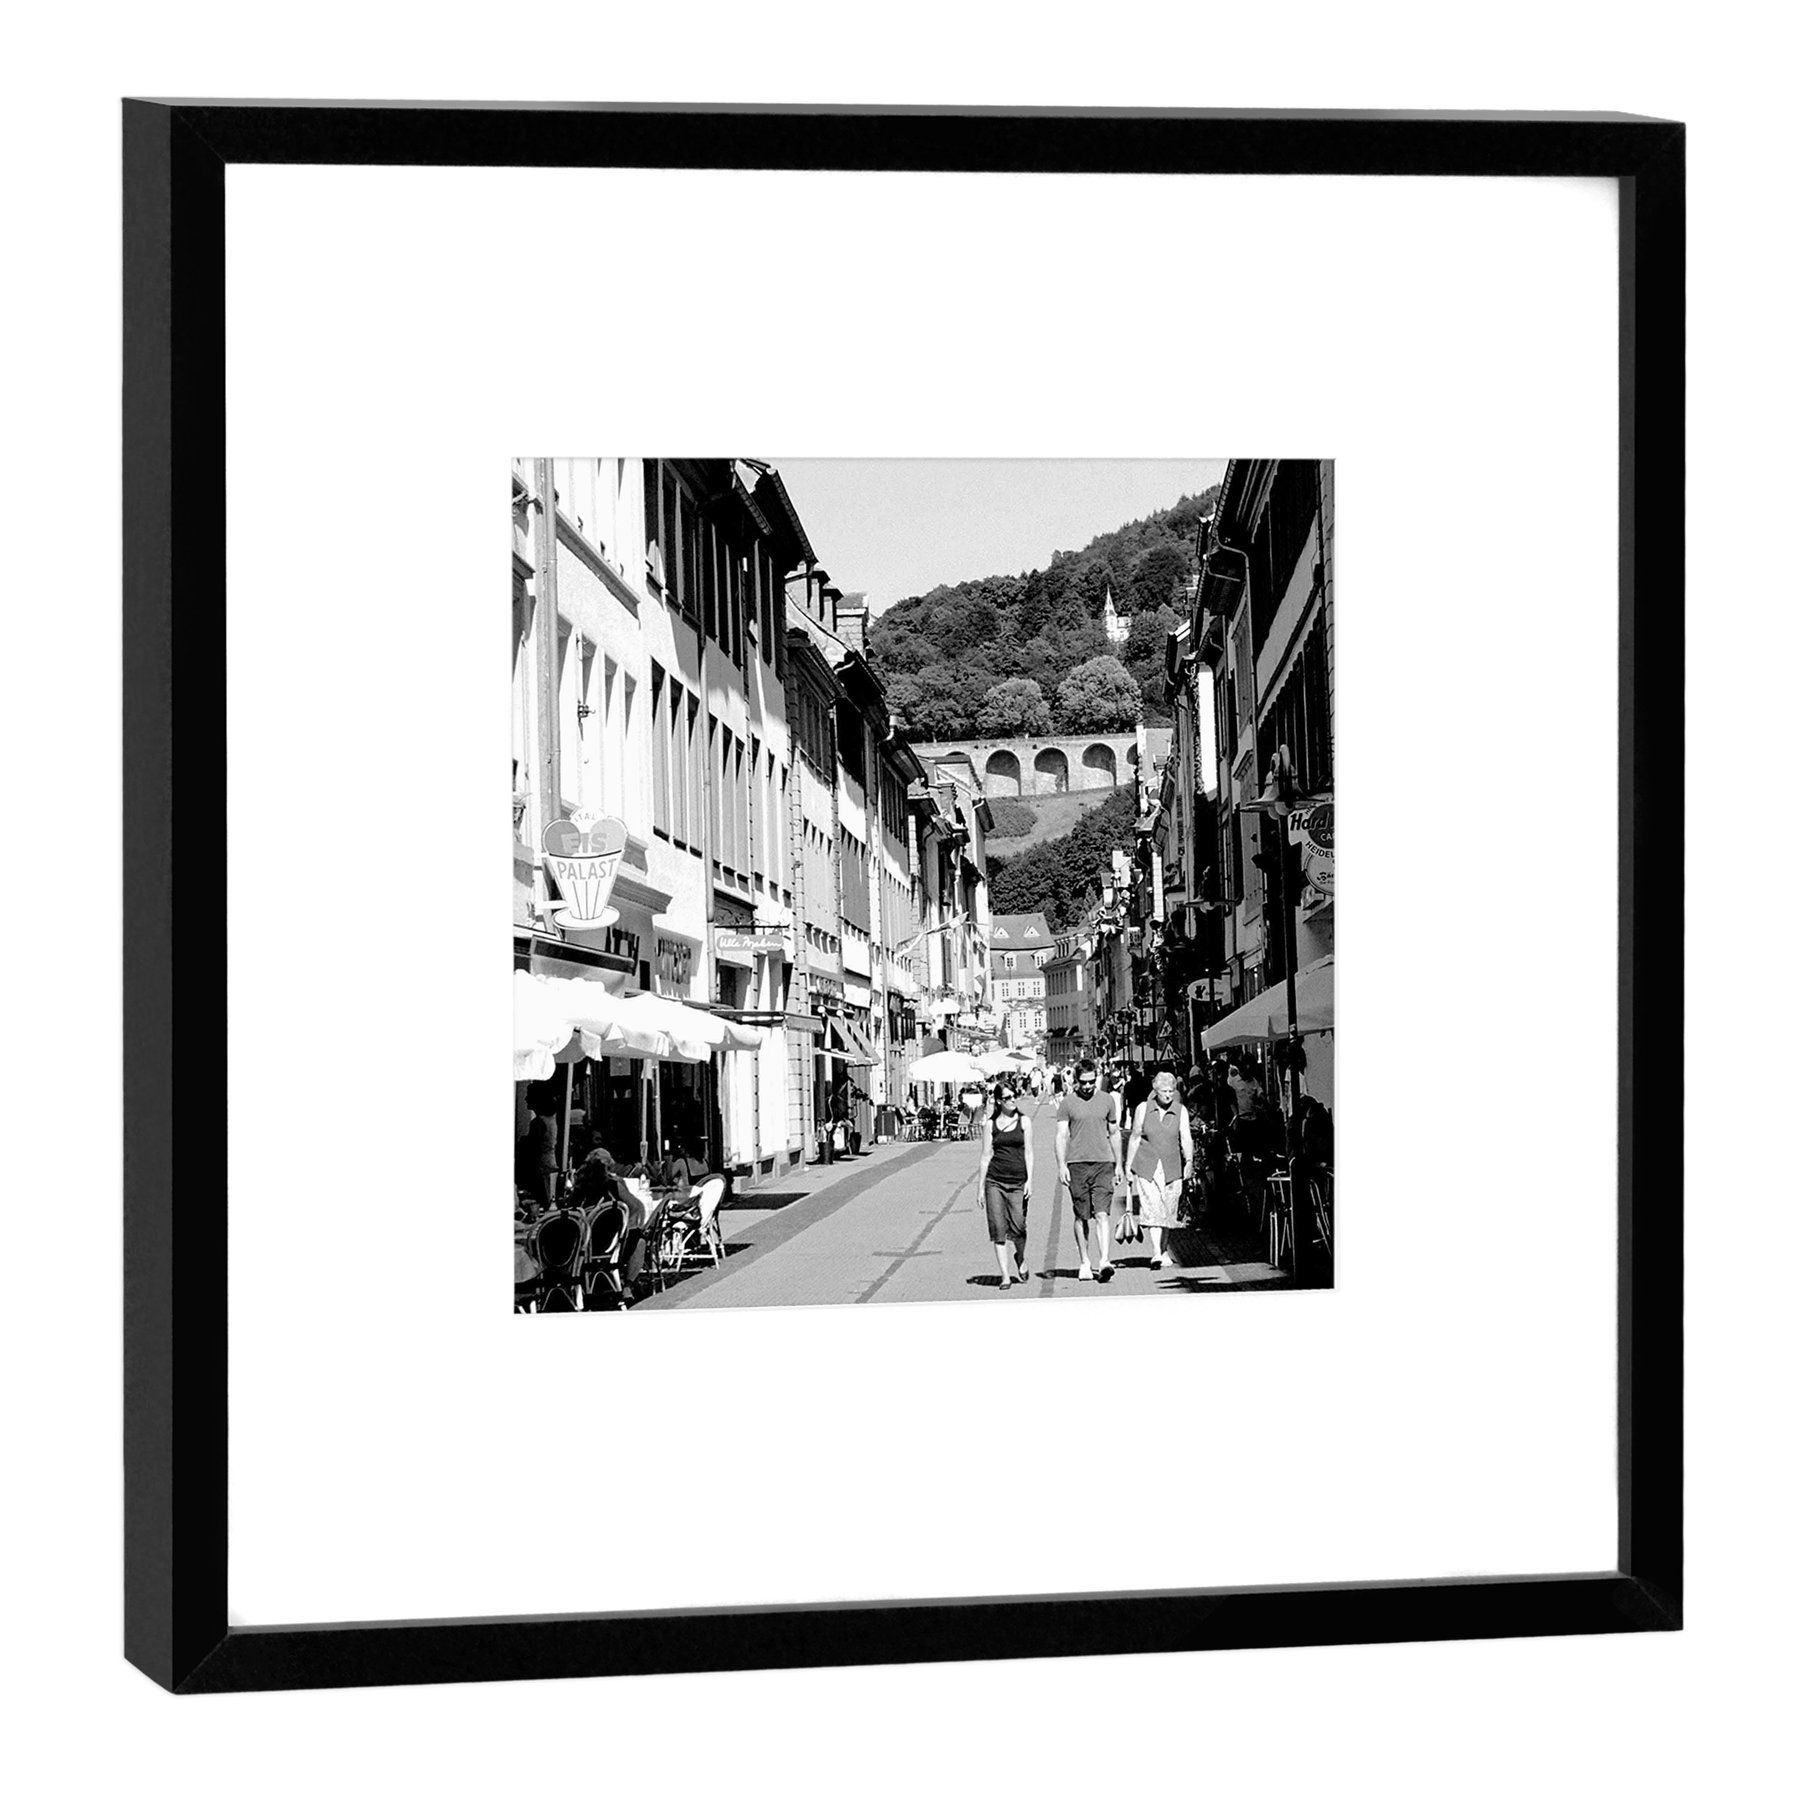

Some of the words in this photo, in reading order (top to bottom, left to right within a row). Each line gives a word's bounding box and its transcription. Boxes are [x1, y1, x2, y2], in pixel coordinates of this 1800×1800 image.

[1290, 811, 1330, 831] Hard
[560, 831, 607, 856] EIS
[1320, 832, 1335, 842] CA
[557, 857, 617, 881] PALAST
